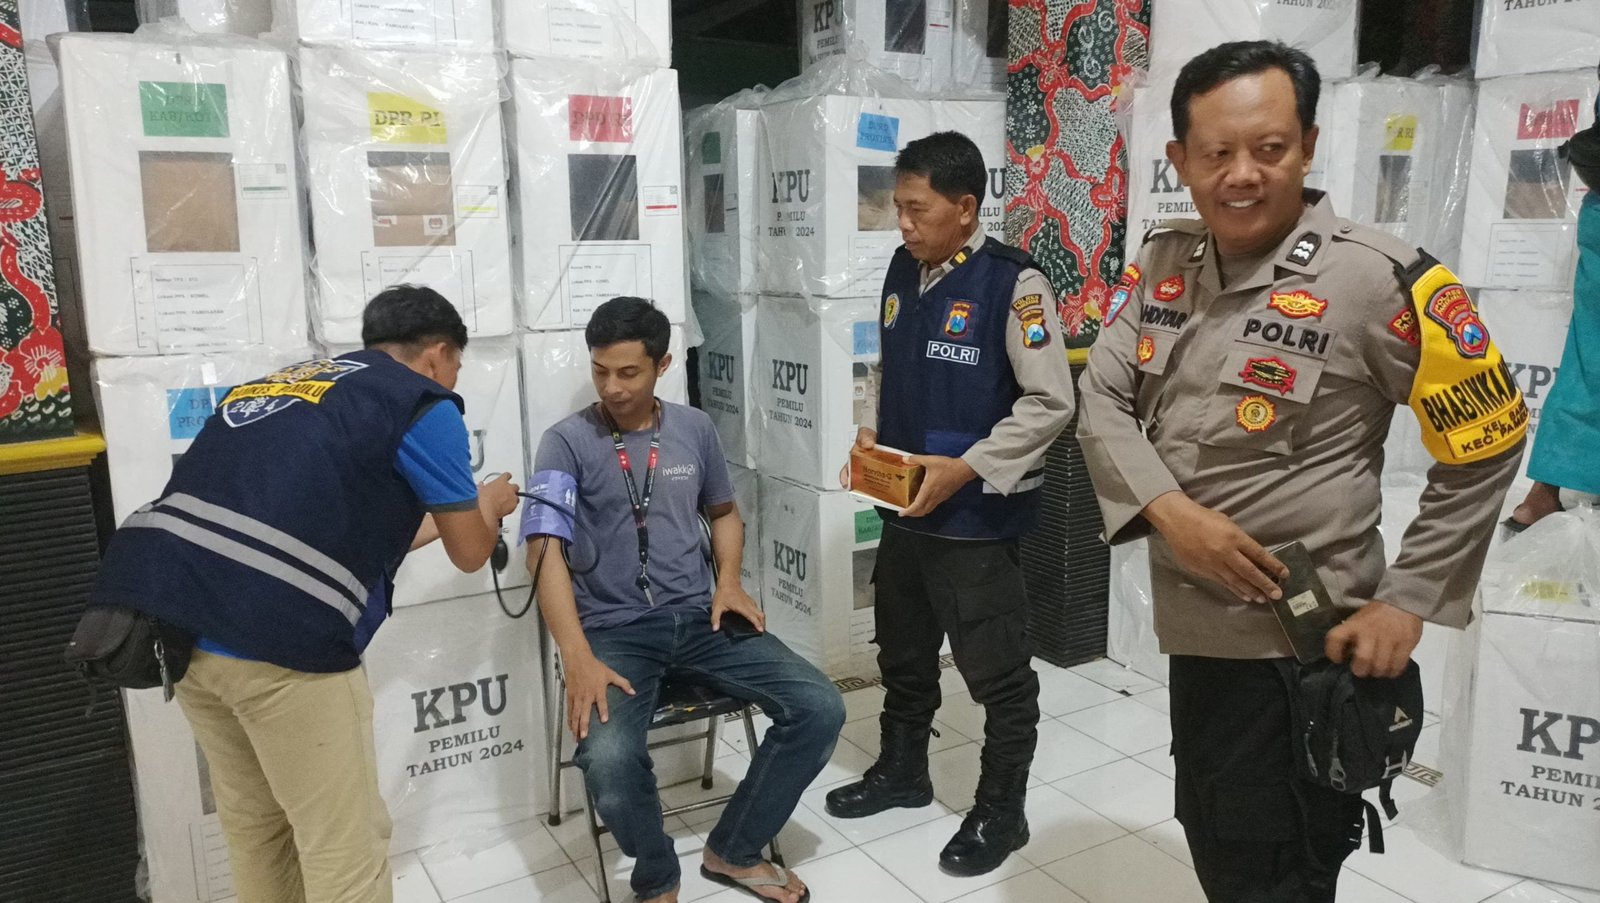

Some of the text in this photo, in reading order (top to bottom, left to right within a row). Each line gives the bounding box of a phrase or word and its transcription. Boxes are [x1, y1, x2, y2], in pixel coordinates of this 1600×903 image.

[813, 0, 844, 33] KPU
[776, 211, 806, 222] PMILU
[1157, 202, 1198, 213] PEMIL
[796, 226, 815, 237] 2024
[1243, 319, 1329, 355] POLRI
[930, 343, 975, 362] POLRI
[708, 351, 735, 384] KPU
[772, 359, 808, 395] KPU
[769, 409, 813, 430] TAHUN 2024
[777, 397, 804, 413] PEMILU
[773, 539, 807, 581] KPU
[771, 586, 812, 616] TAHUN 2024
[778, 578, 803, 598] PEMILU
[411, 673, 508, 733] KPU
[428, 725, 501, 754] PEMILU
[406, 739, 524, 777] TAHUN 2024
[1501, 780, 1584, 807] TAHUN
